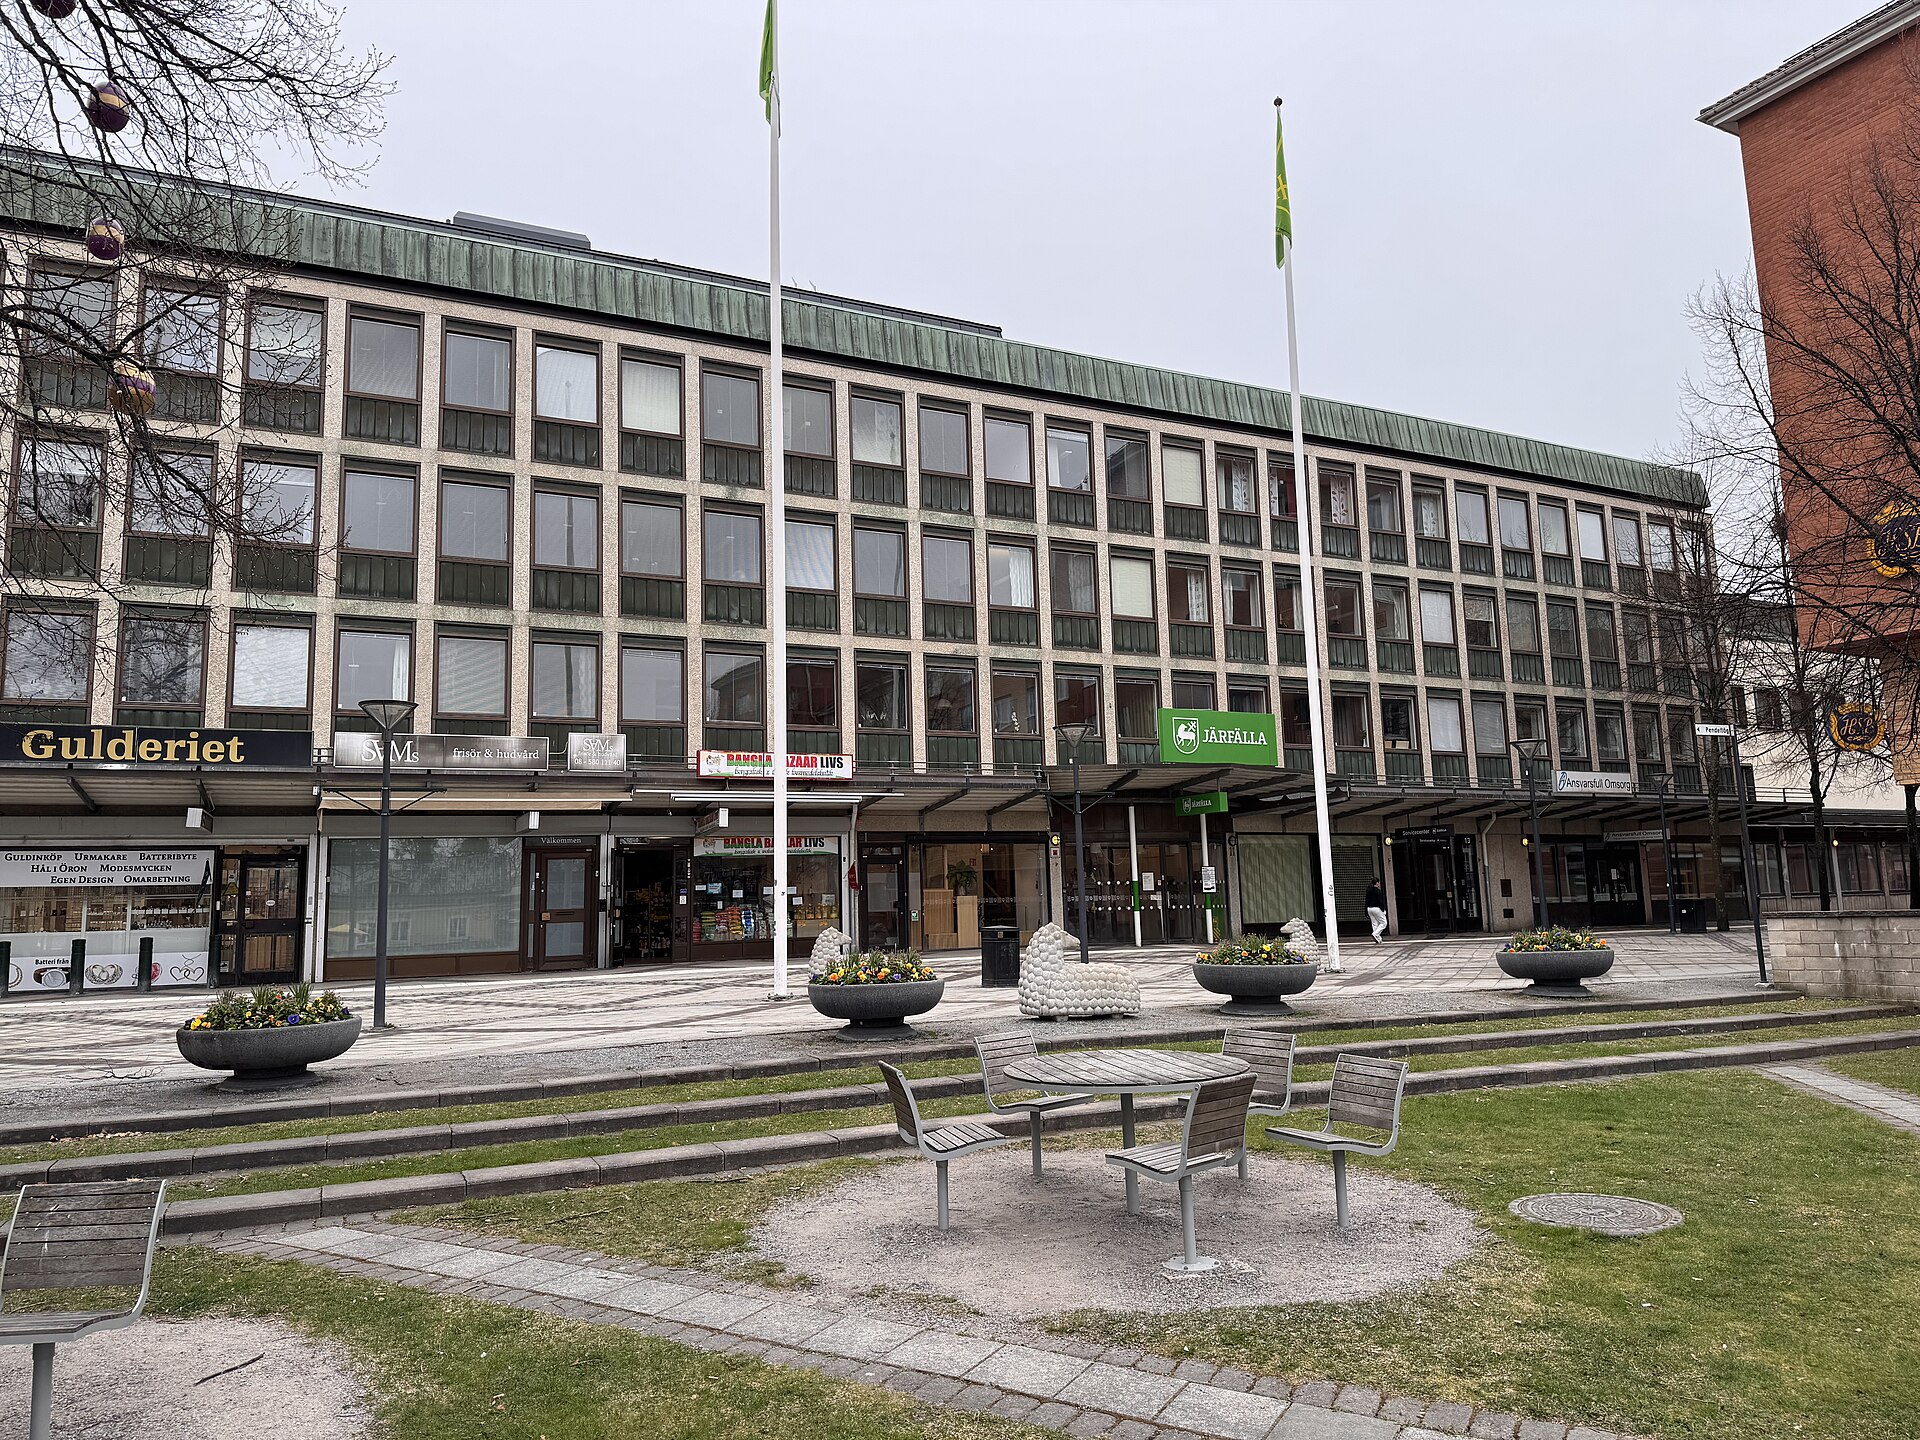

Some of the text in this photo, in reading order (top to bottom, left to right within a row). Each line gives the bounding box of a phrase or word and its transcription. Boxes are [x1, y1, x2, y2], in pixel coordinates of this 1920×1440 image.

[1202, 726, 1268, 745] JÄRFÄLLA
[21, 729, 245, 762] Gulderiet
[452, 748, 540, 759] frisör & hudvård
[726, 754, 773, 767] BANGLA
[820, 756, 844, 769] LIVS
[1566, 778, 1630, 792] Ansvarsfull Omsorg
[724, 838, 763, 849] BANGLA
[804, 838, 825, 848] LIVS
